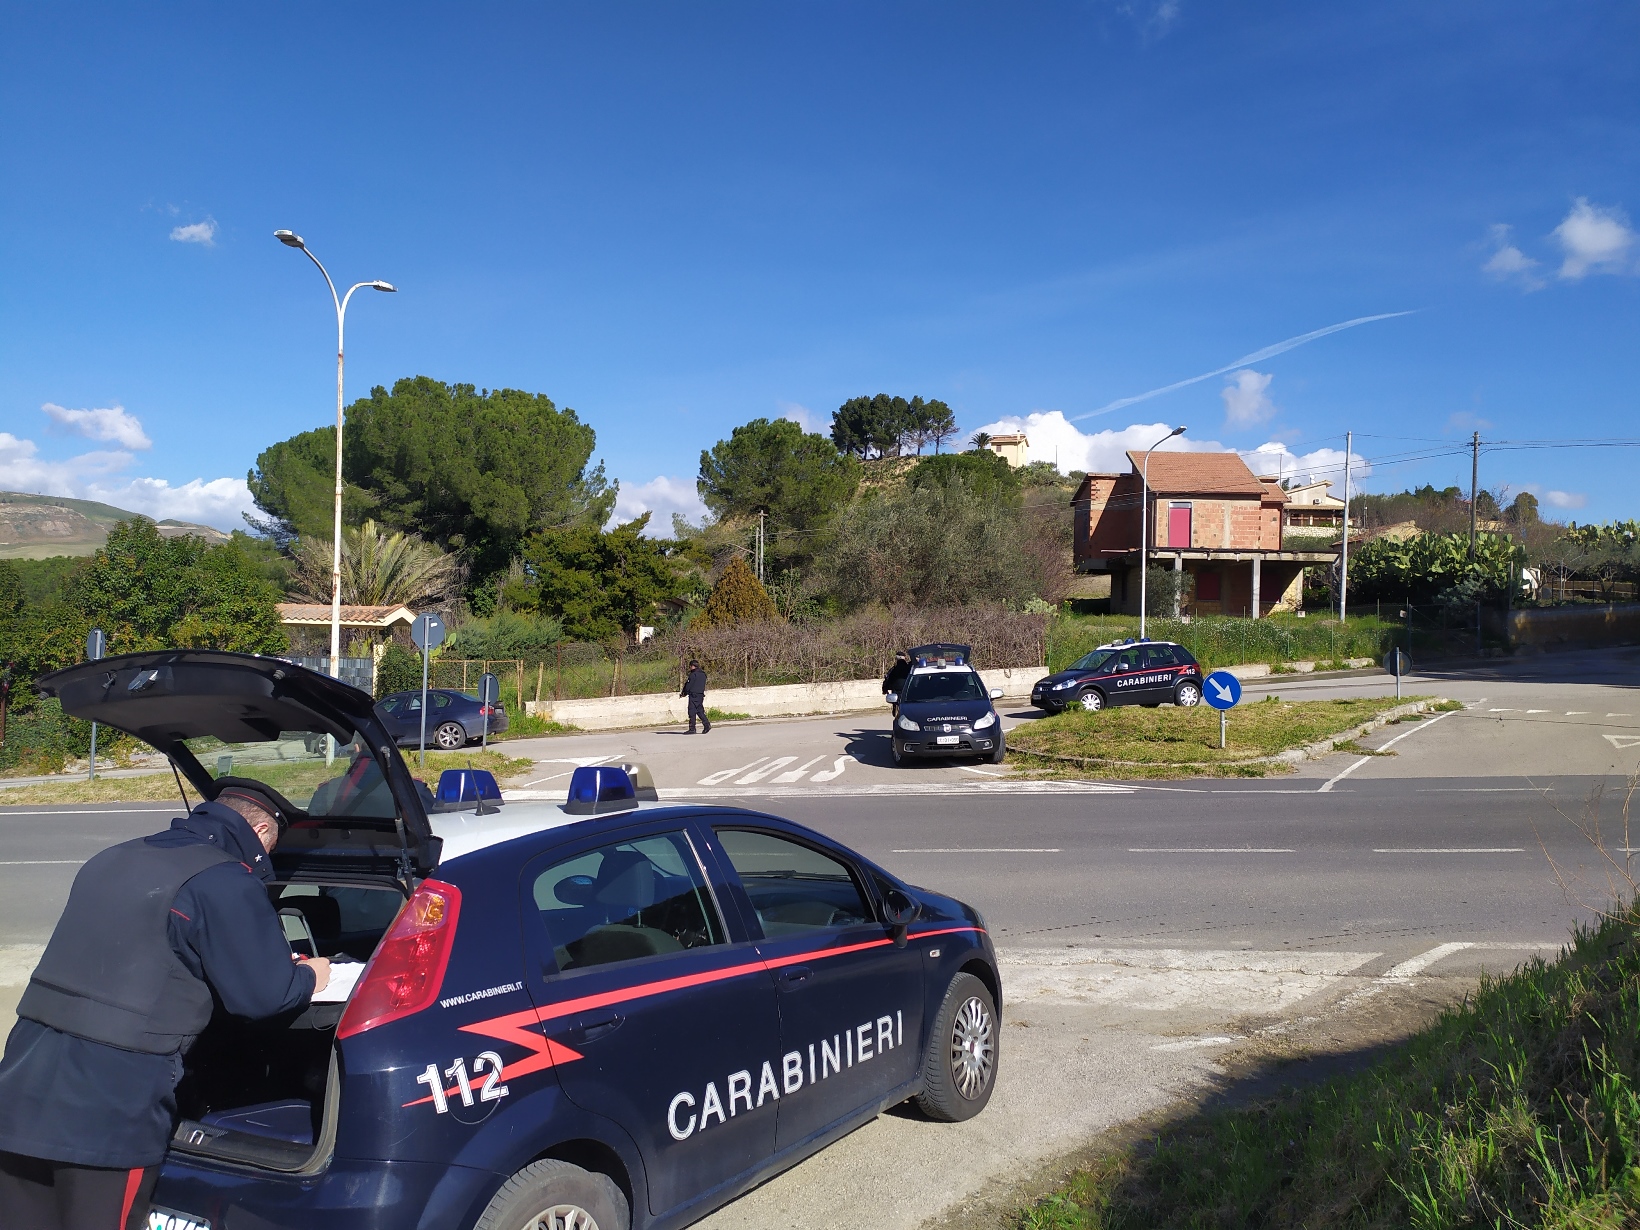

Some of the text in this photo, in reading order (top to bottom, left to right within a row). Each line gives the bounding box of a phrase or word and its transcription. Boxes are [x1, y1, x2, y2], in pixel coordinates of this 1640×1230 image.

[1117, 674, 1171, 687] CARABINIERI
[440, 981, 523, 1009] WWW.CARABINIERI.IT
[416, 1050, 510, 1114] 112
[667, 1010, 903, 1141] CARABINIERI
